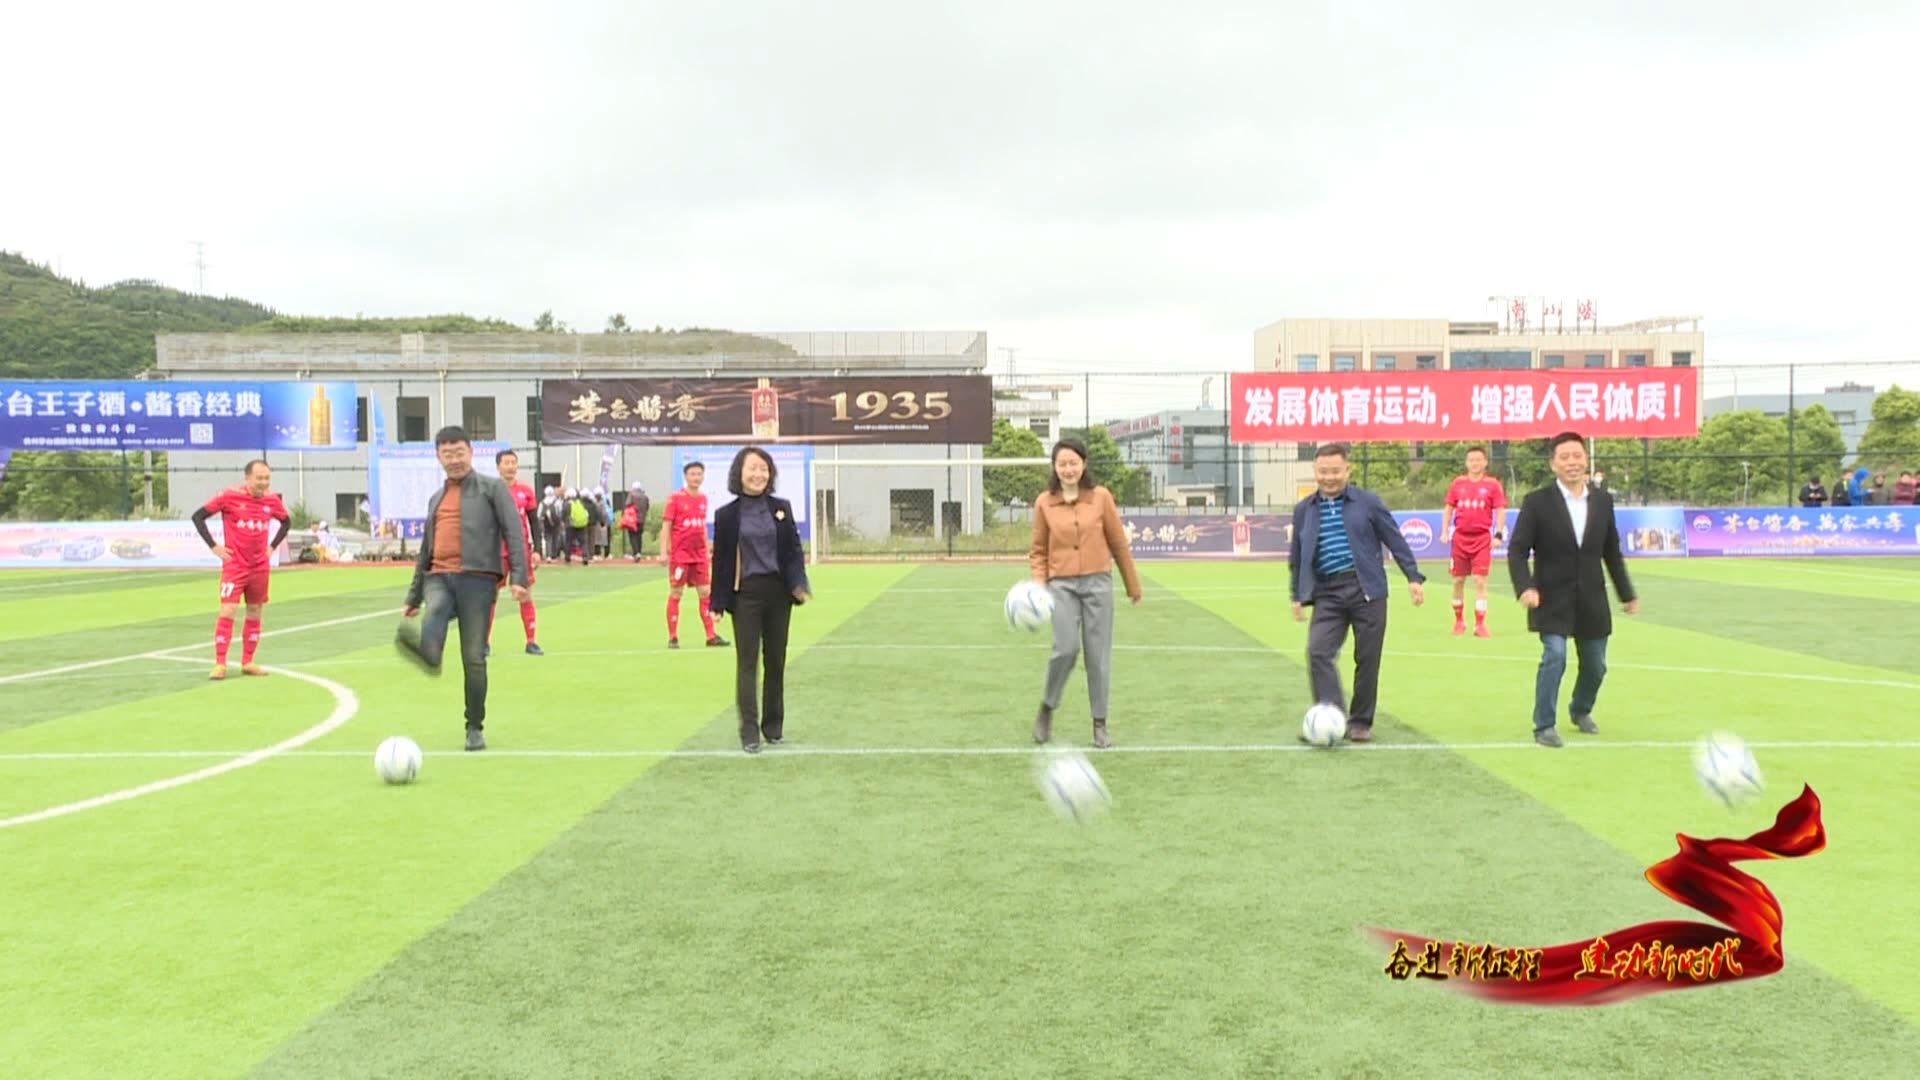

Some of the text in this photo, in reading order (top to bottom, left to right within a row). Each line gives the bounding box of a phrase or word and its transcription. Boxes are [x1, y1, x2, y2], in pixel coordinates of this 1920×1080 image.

[0, 390, 263, 417] 台王子酒·酱香经典
[829, 390, 952, 421] 1935
[1244, 383, 1683, 427] 发展体育运动，增强人民体质！
[220, 581, 235, 598] 27
